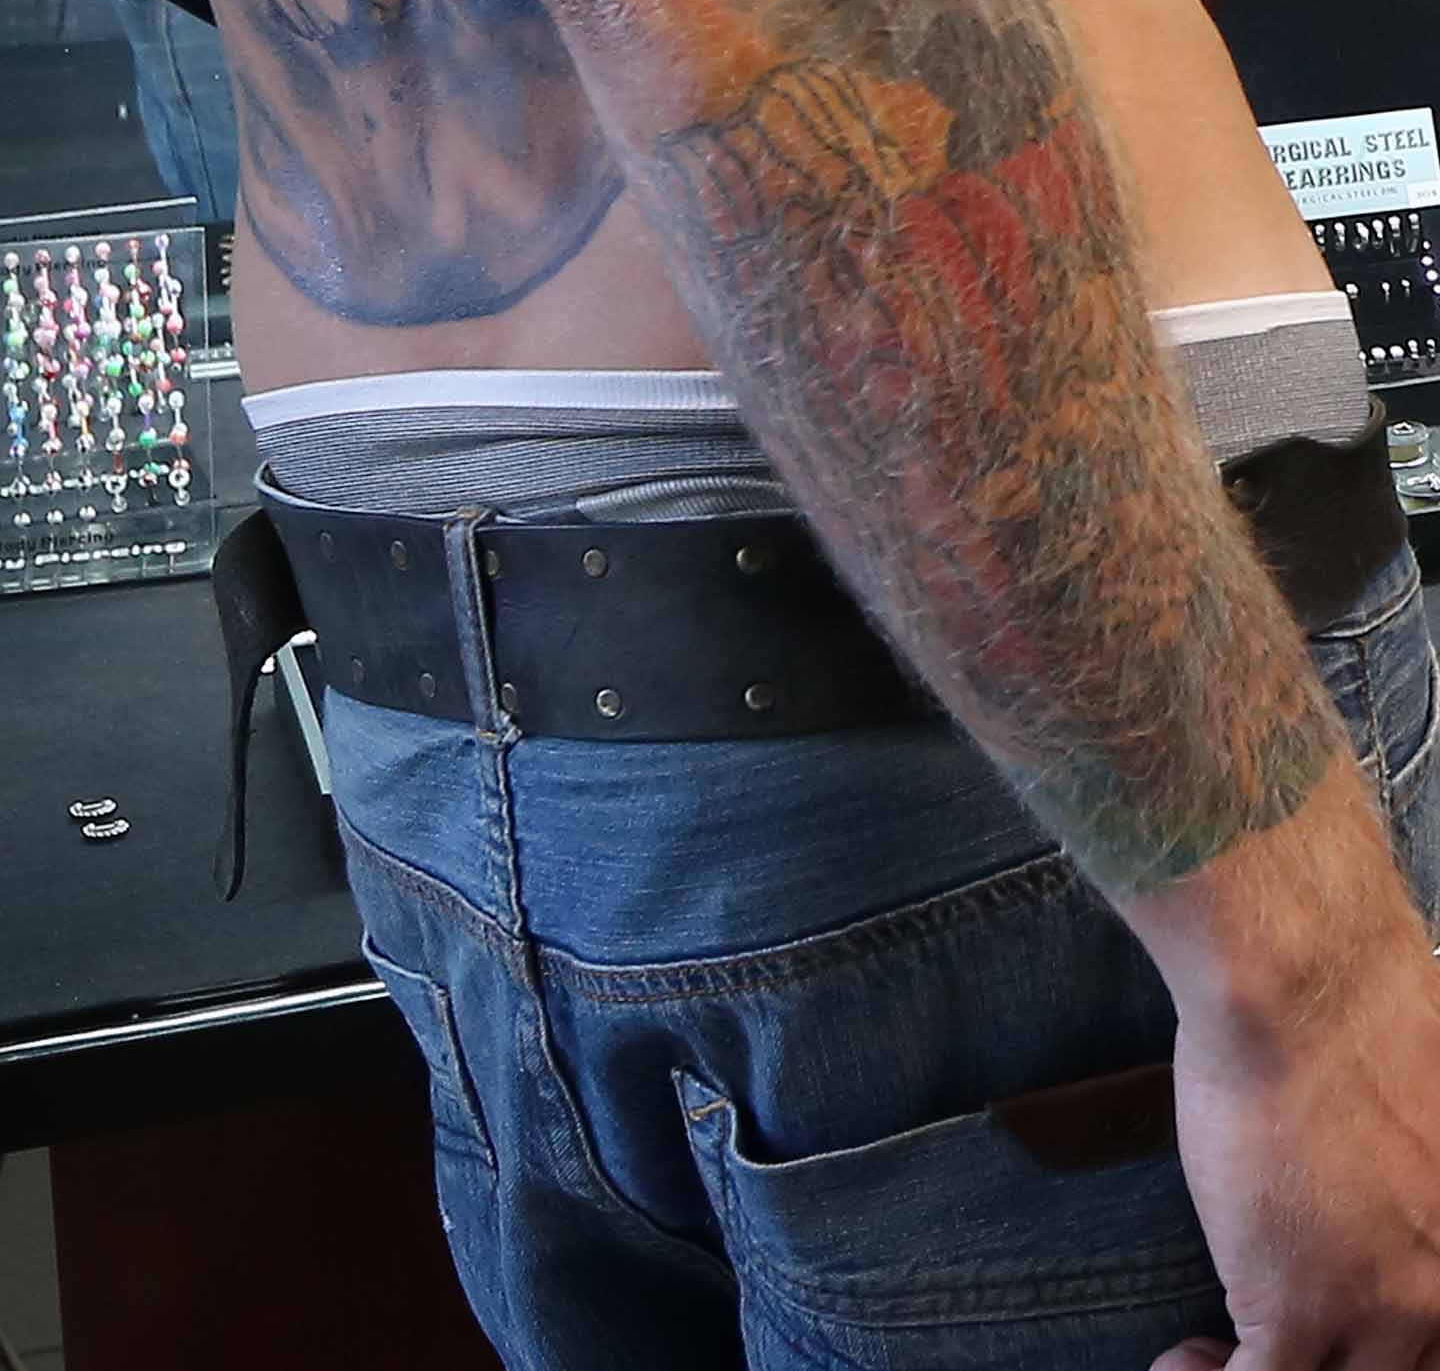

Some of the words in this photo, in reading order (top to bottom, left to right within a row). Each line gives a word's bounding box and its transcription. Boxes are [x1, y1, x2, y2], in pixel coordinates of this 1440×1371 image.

[1271, 136, 1352, 164] RGICAL
[1364, 128, 1431, 154] STEEL
[1283, 158, 1407, 191] EARRINGS
